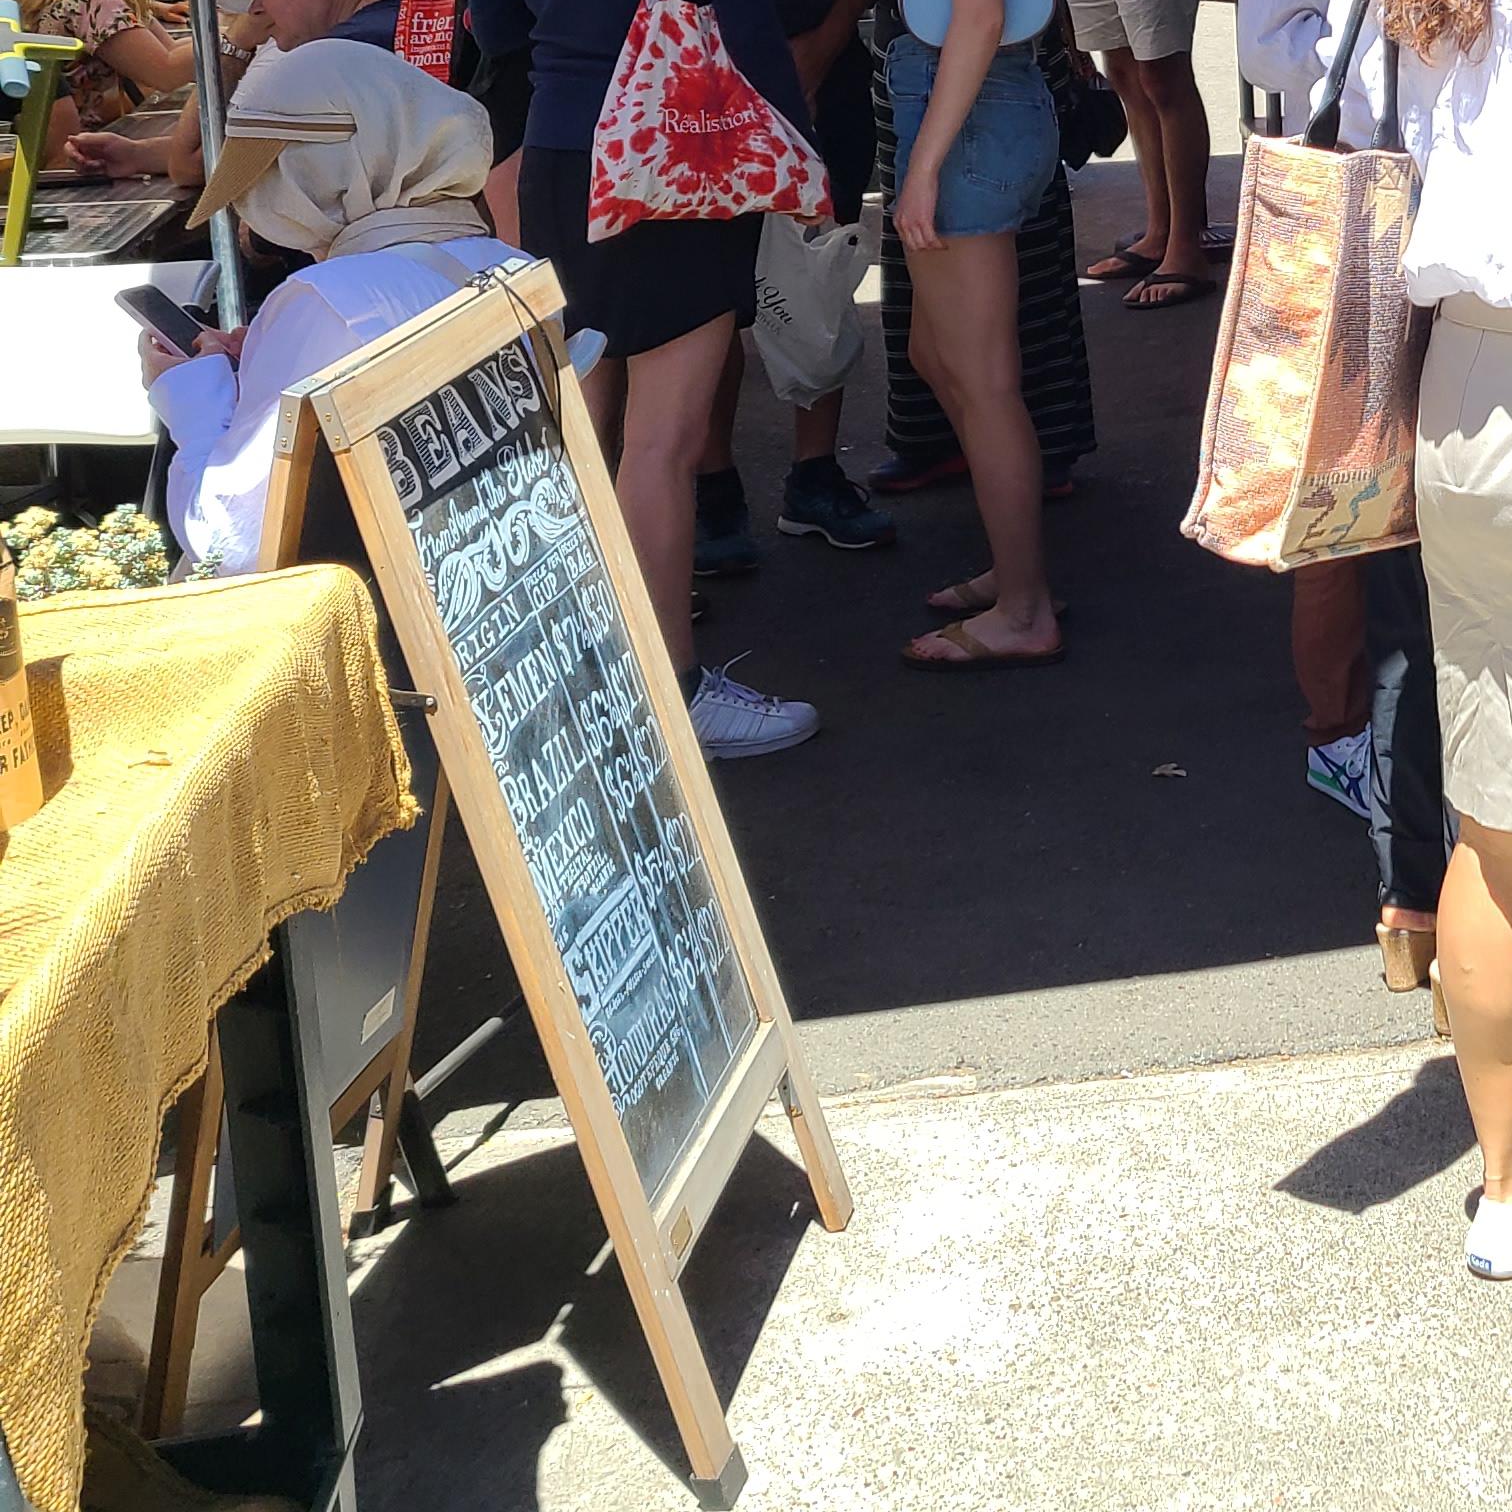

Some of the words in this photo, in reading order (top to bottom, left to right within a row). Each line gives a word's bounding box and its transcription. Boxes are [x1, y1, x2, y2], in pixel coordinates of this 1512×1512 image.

[376, 343, 541, 511] BEANS
[478, 467, 506, 510] the
[532, 571, 557, 610] CUP
[566, 544, 593, 578] BAG
[580, 579, 613, 643] $30
[450, 593, 520, 670] RIGIN
[499, 726, 586, 833] BRAZIL
[608, 650, 643, 725] $17
